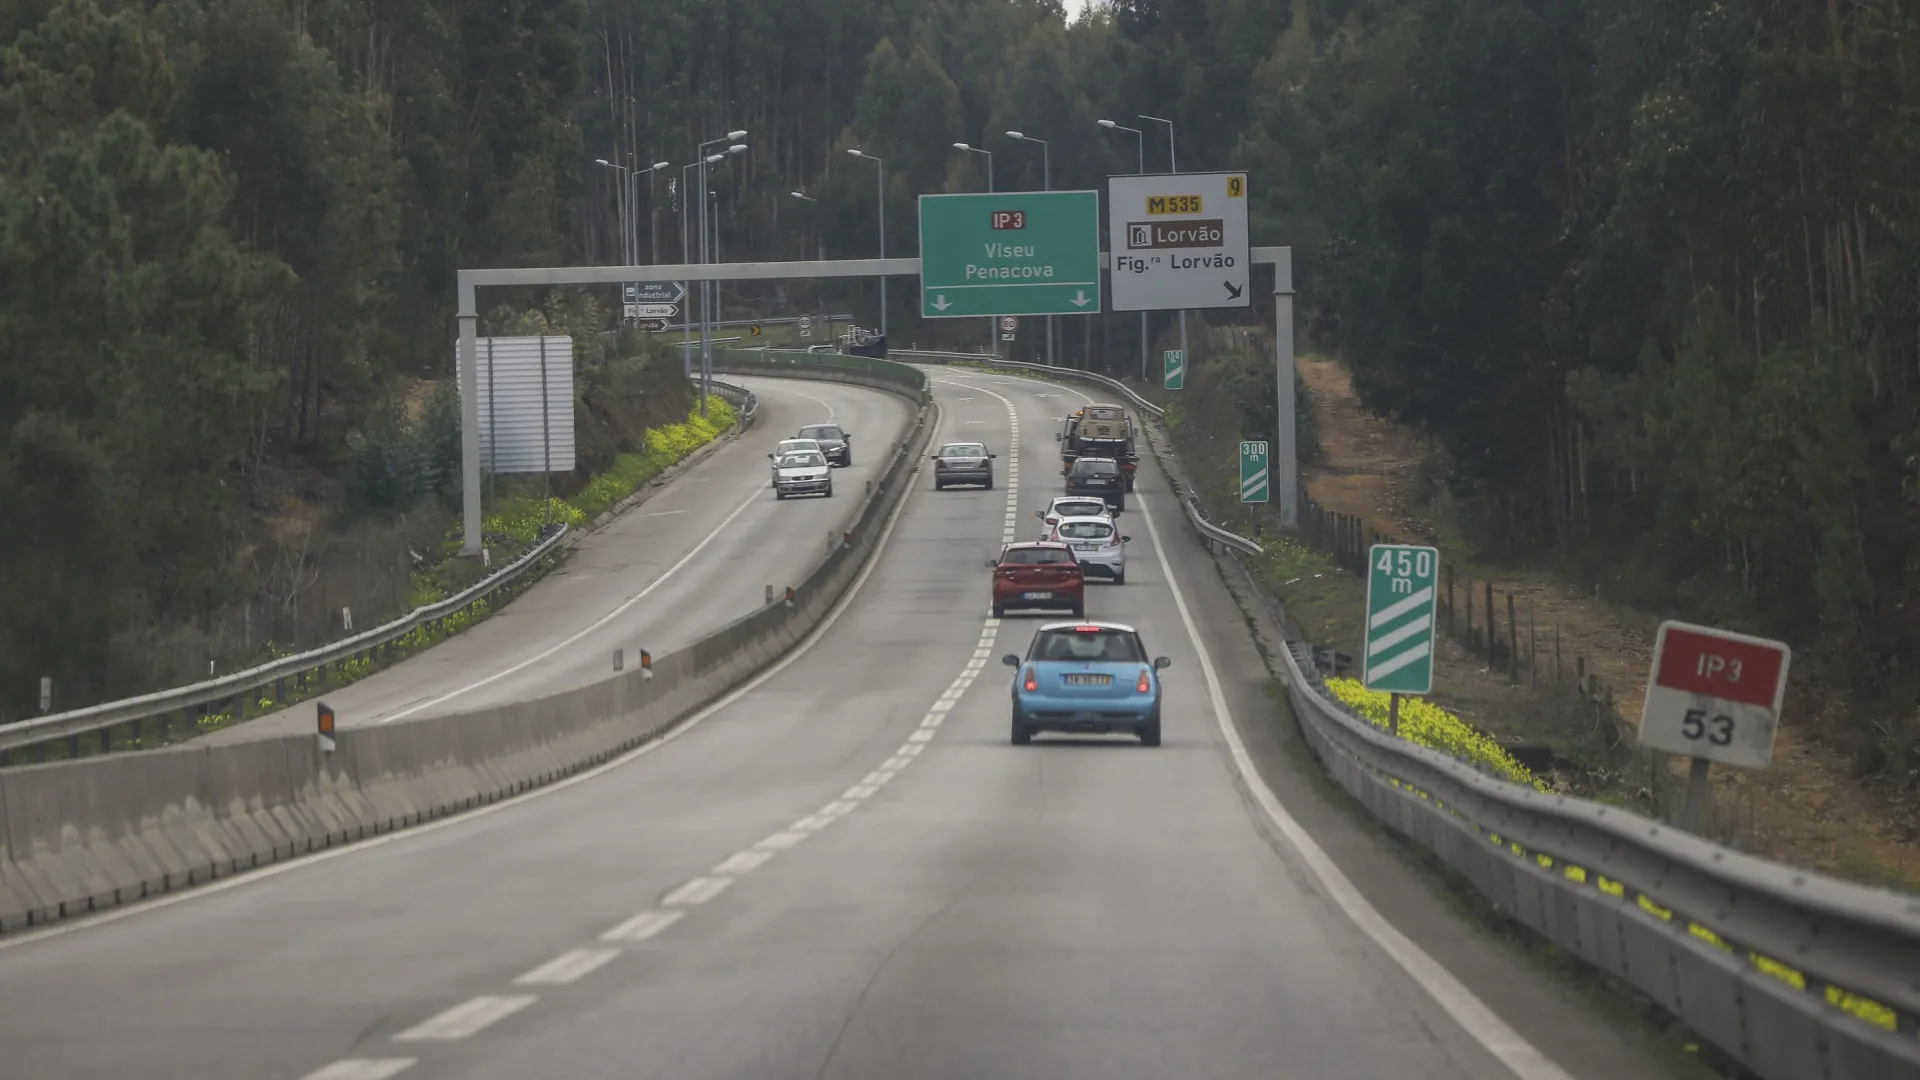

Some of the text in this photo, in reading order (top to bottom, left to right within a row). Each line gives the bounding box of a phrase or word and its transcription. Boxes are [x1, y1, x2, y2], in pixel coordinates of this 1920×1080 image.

[1230, 178, 1240, 196] 9
[1157, 226, 1221, 243] Lorvão
[984, 242, 1035, 258] Viseu
[1170, 253, 1235, 270] Lorvão
[965, 264, 1054, 280] Penacova
[1167, 352, 1180, 360] 150
[1243, 443, 1265, 455] 300
[1376, 550, 1431, 576] 450
[1391, 577, 1412, 593] m
[1681, 708, 1735, 746] 53
